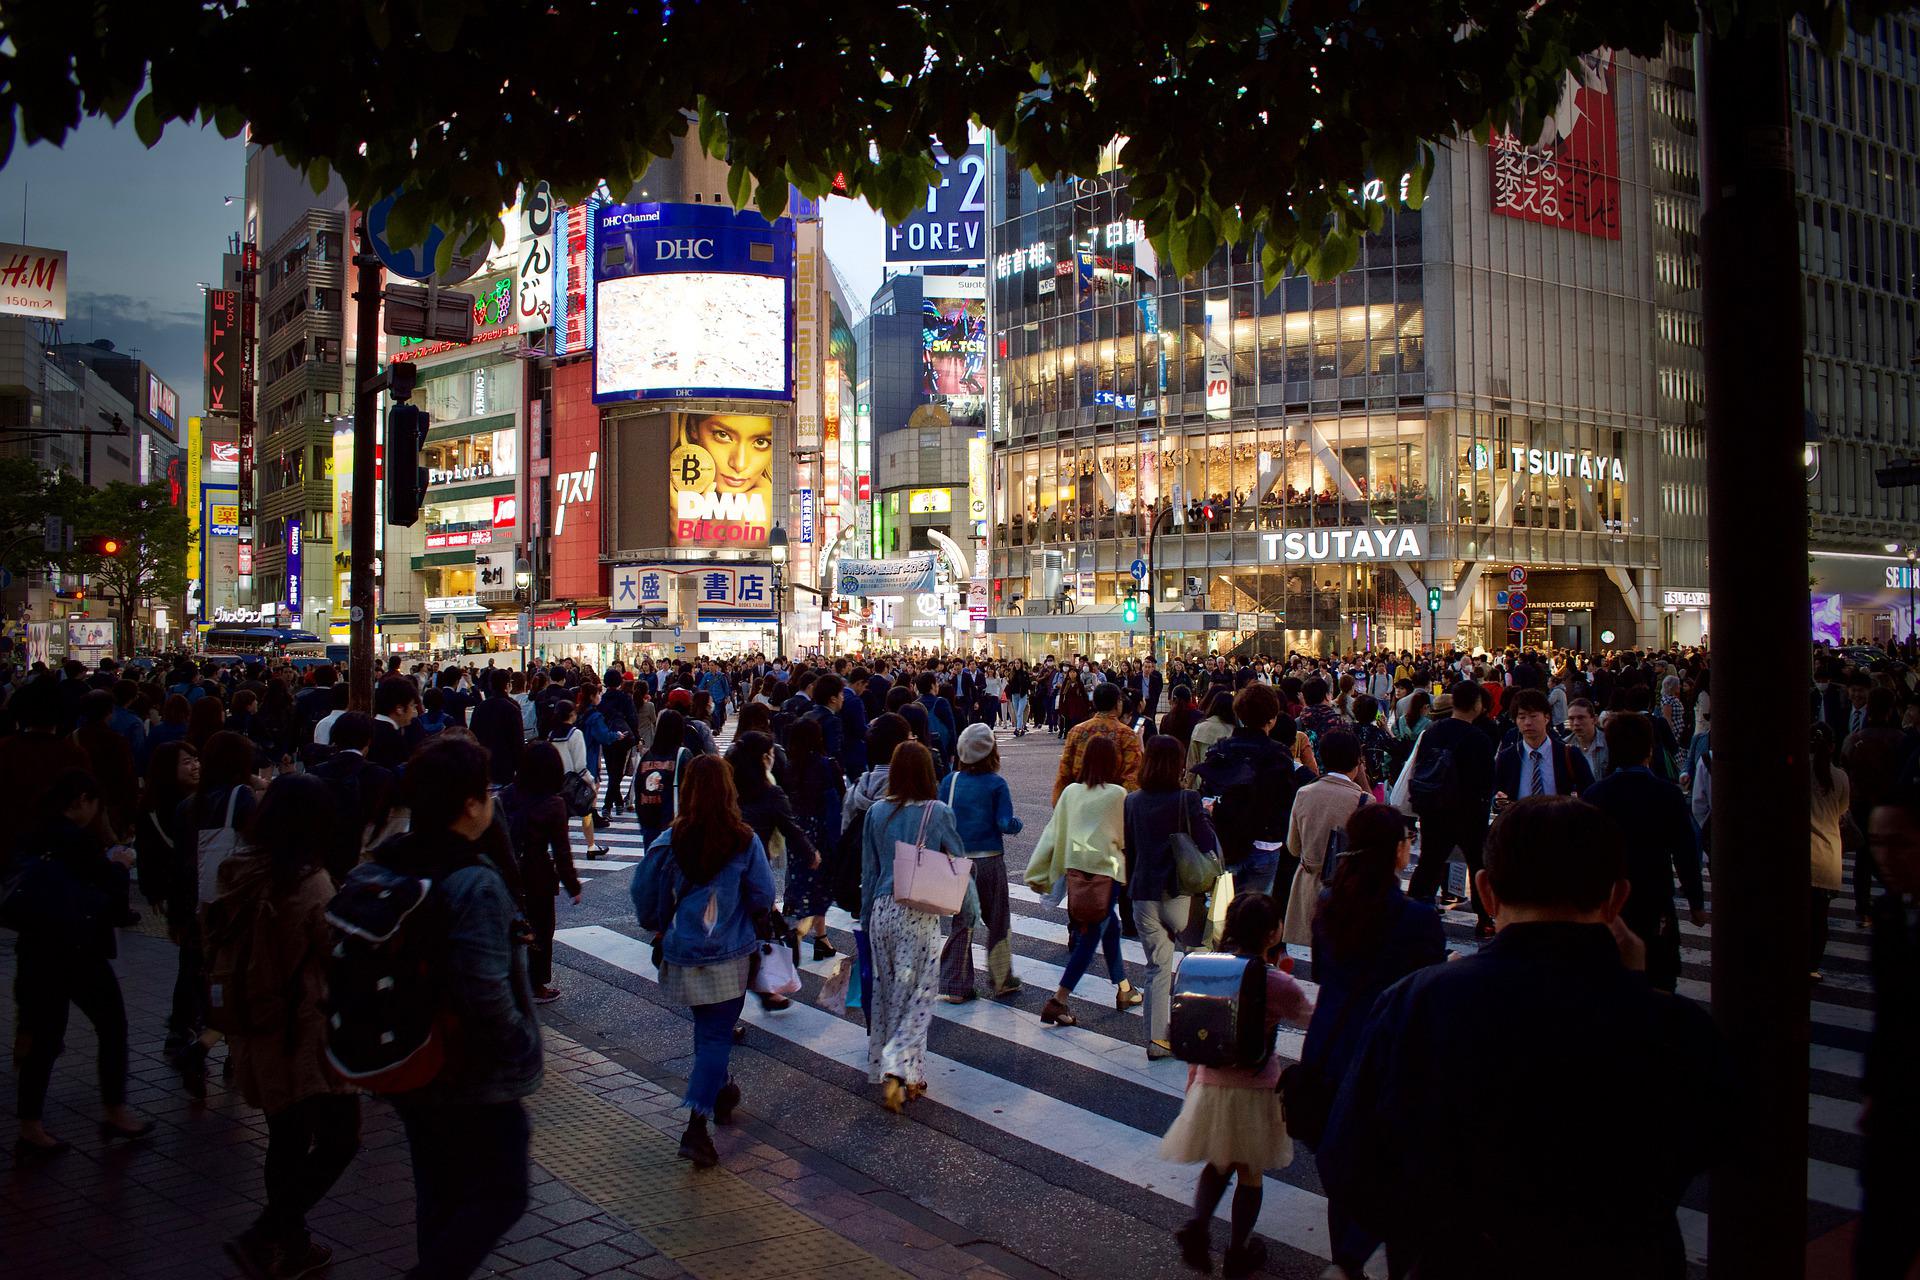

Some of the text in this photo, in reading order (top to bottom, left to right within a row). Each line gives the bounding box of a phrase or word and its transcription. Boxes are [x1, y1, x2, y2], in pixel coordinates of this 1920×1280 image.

[1495, 170, 1565, 222] 変える、
[1563, 189, 1616, 228] テレビ
[603, 211, 660, 227] DHC Channel
[655, 239, 714, 260] DHC
[1, 253, 60, 292] H&M
[6, 297, 40, 309] 150m
[212, 290, 236, 410] KATE TOKYO
[675, 389, 693, 397] DHC
[429, 462, 490, 485] Euphoria
[1511, 447, 1625, 482] TSUTAYA
[678, 490, 767, 521] DMM
[291, 527, 299, 555] MIZUHO
[677, 520, 766, 542] Bitcoin
[1263, 528, 1421, 561] TSUTAYA
[618, 572, 765, 602] 大盛書店
[1664, 592, 1705, 605] TSUTAYA
[214, 606, 262, 623] グルメタウン
